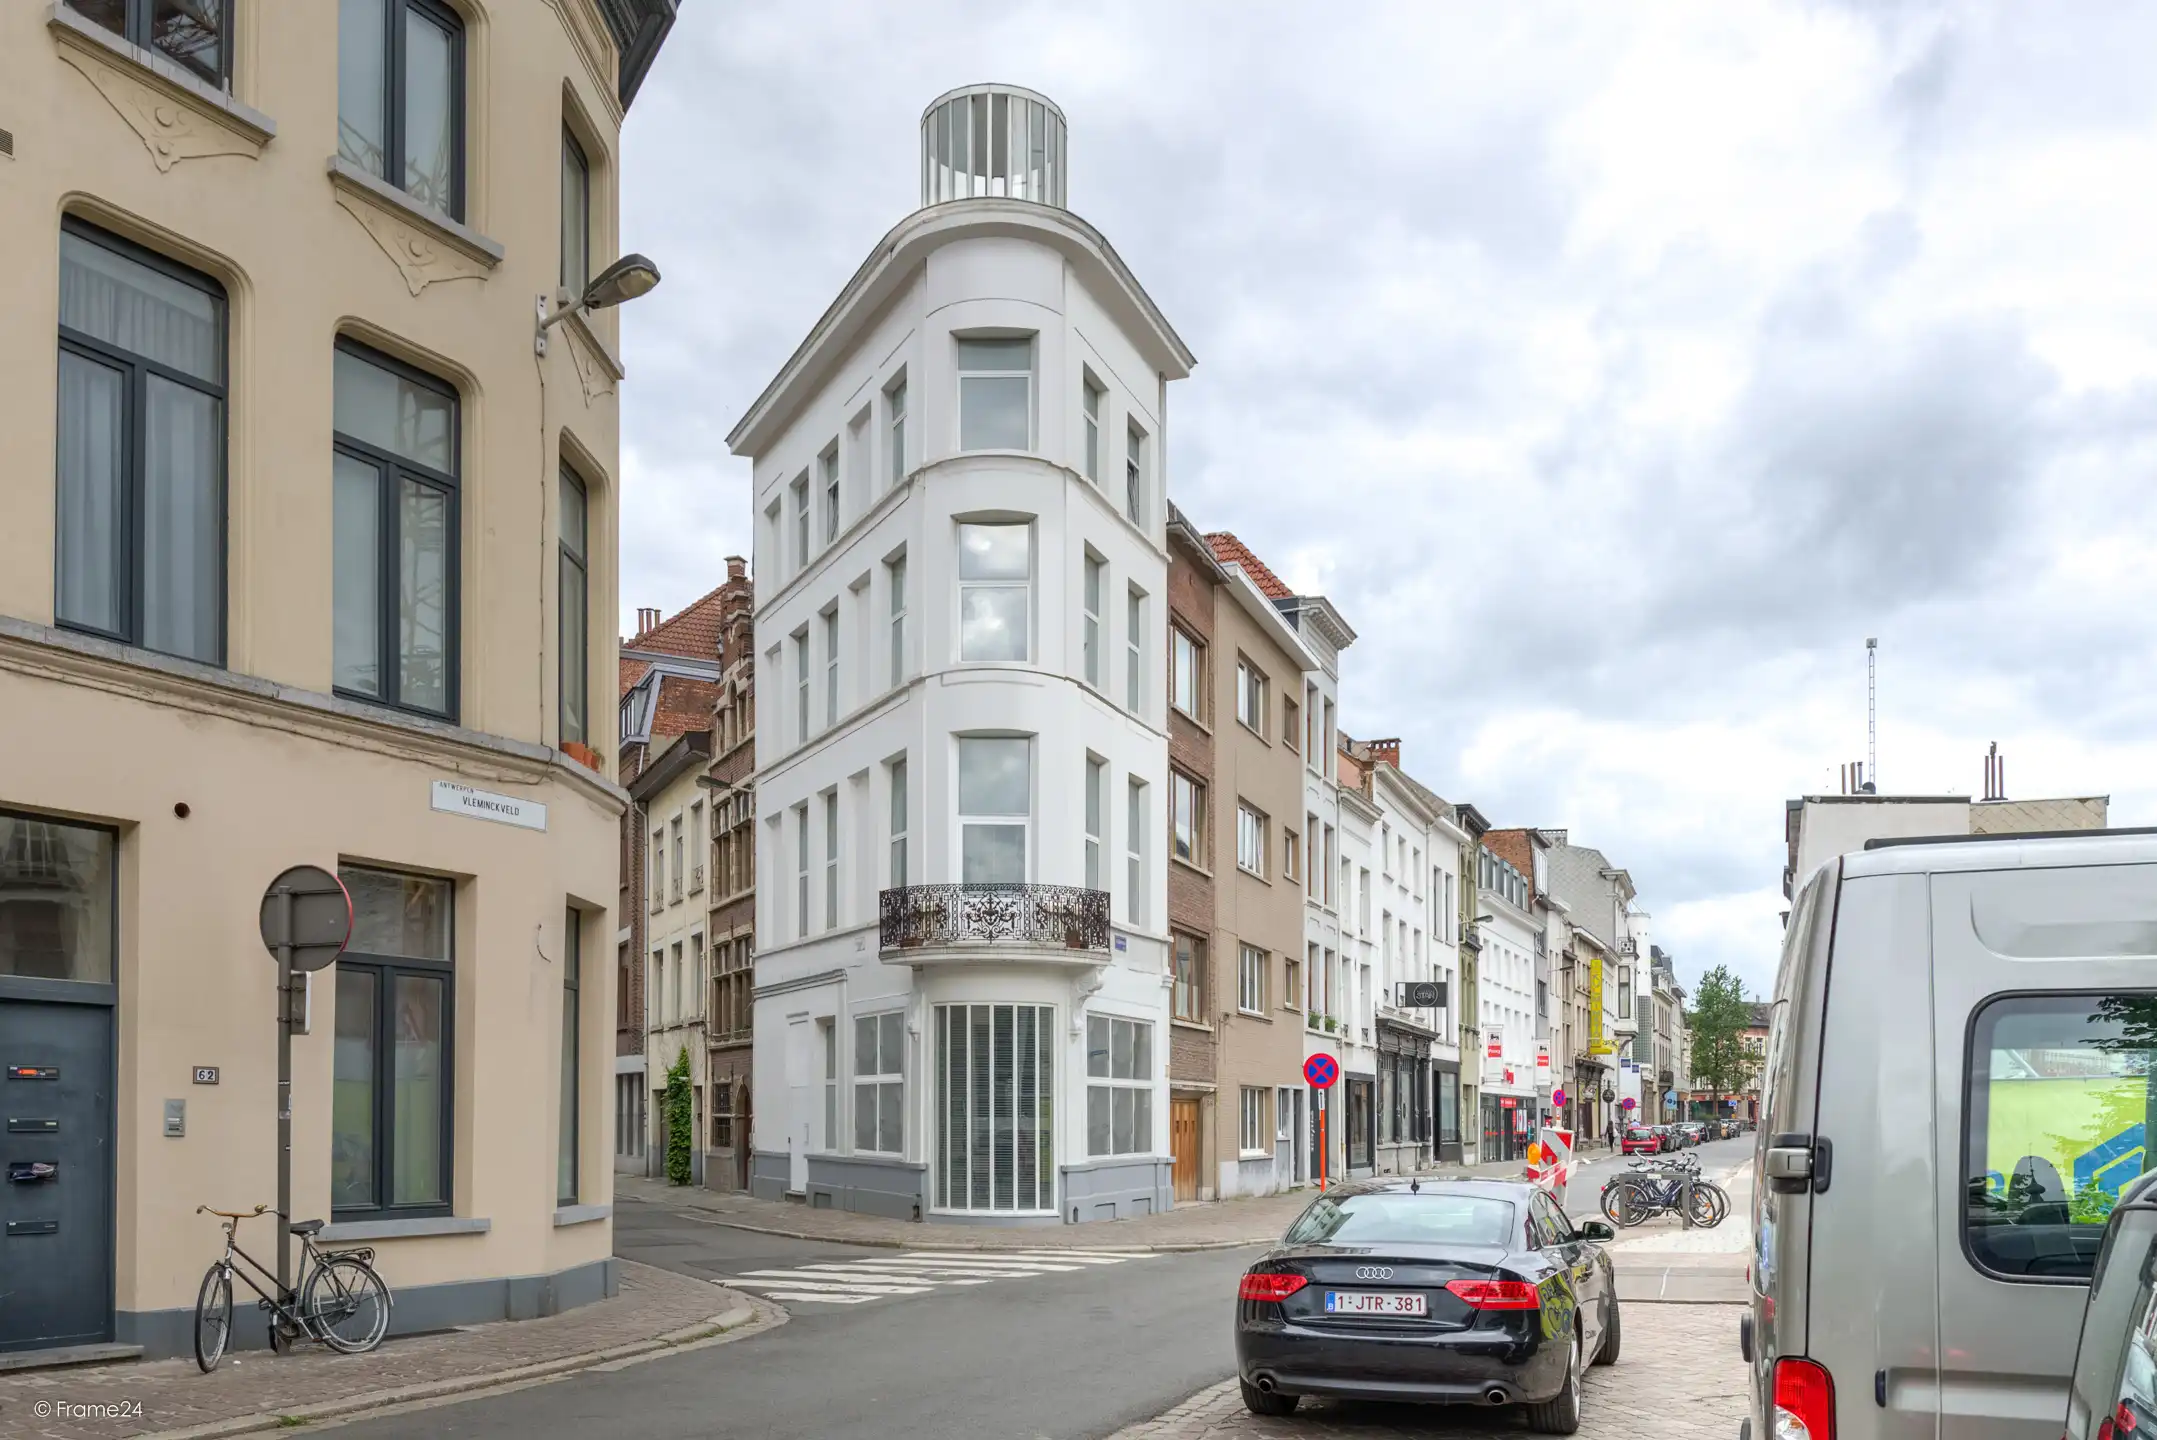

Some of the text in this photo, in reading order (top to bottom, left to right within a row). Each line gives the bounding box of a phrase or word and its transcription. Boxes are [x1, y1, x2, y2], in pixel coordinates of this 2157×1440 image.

[462, 796, 520, 816] VLEMINCKVELD
[198, 1070, 214, 1080] 62
[1338, 1296, 1422, 1312] 1-JTR-381
